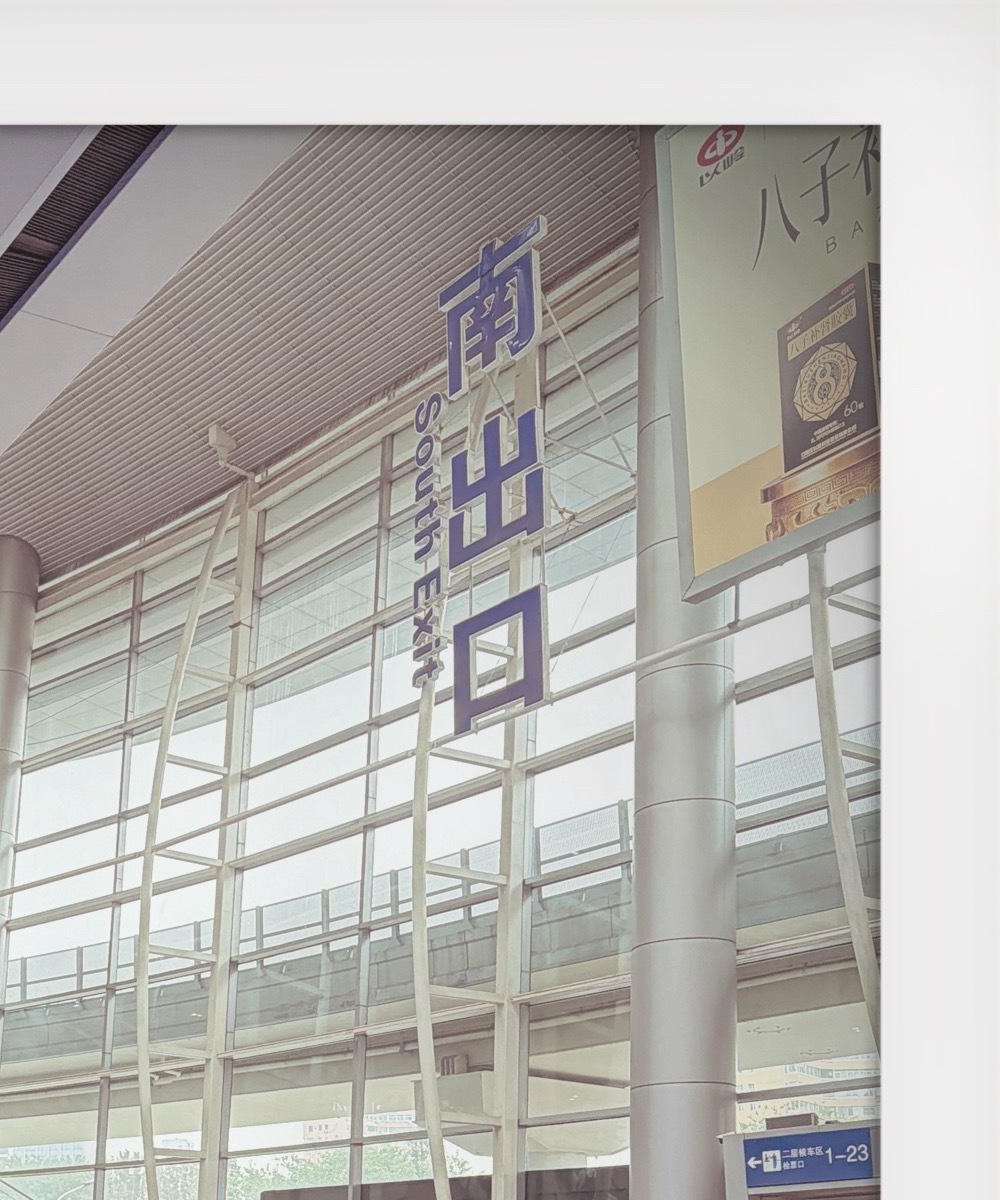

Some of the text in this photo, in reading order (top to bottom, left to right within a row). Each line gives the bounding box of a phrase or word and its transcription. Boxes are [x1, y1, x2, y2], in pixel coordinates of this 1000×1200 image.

[412, 392, 444, 686] South Exit
[439, 215, 546, 736] 南出口
